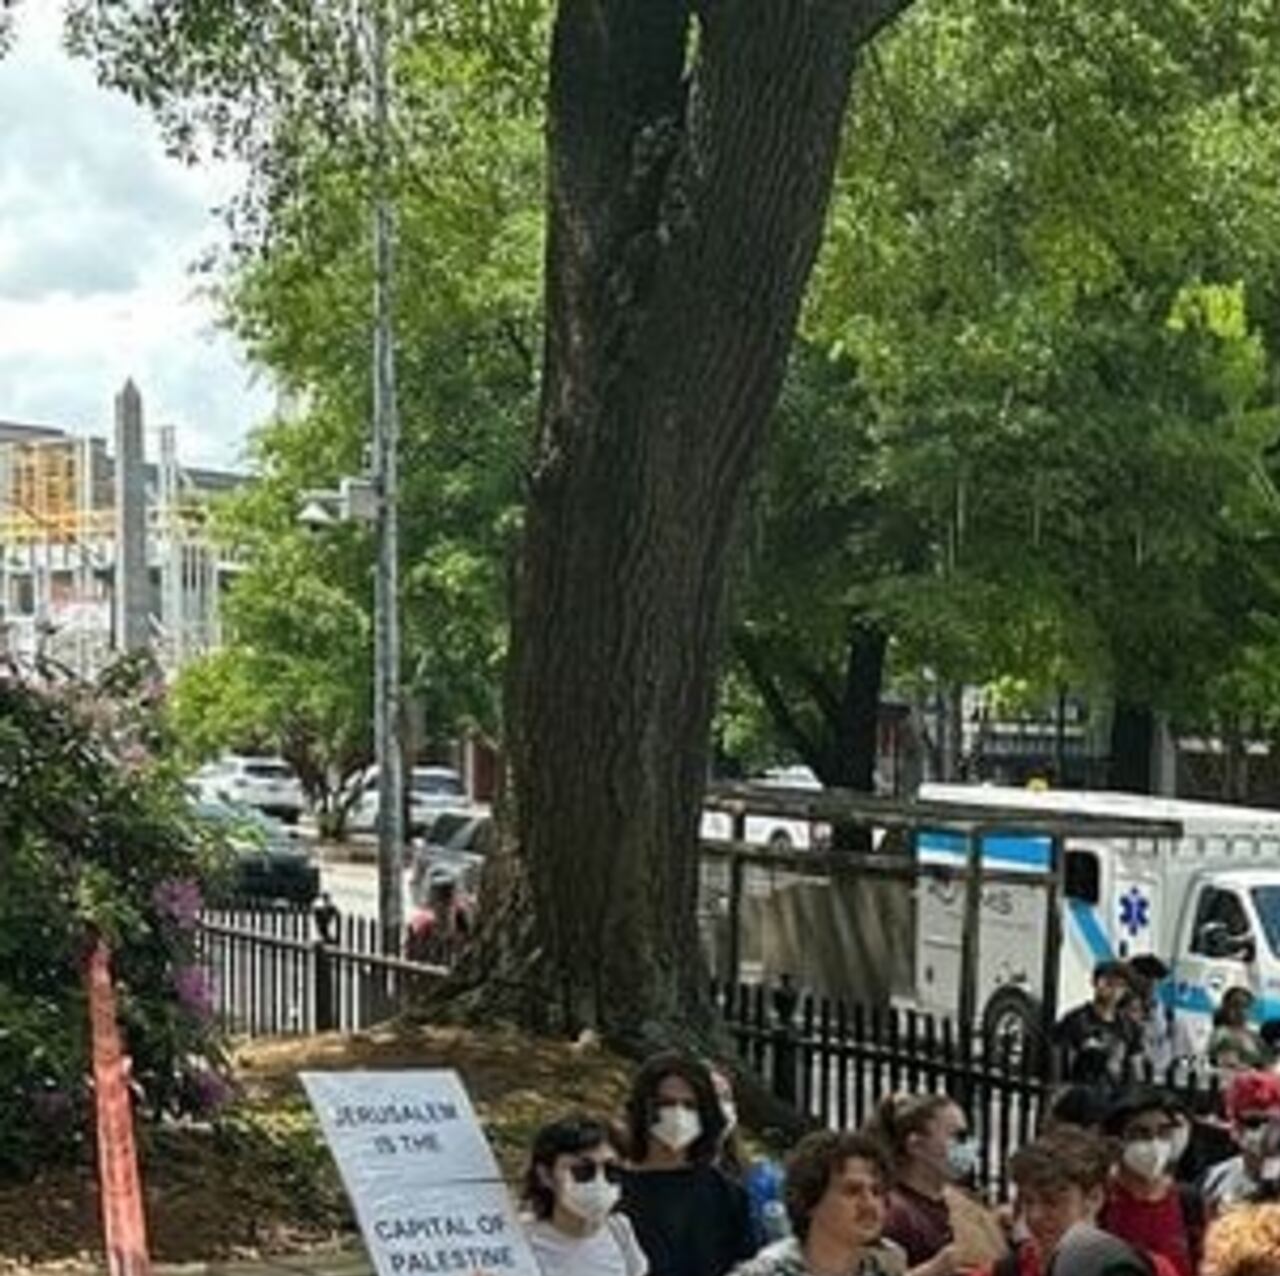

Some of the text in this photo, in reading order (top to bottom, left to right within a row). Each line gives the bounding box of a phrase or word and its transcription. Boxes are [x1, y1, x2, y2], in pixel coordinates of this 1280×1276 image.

[335, 1103, 458, 1127] JERUSALEM
[373, 1133, 441, 1154] IS THE
[374, 1214, 505, 1240] CAPITAL OF
[390, 1246, 516, 1273] PALESTINE
